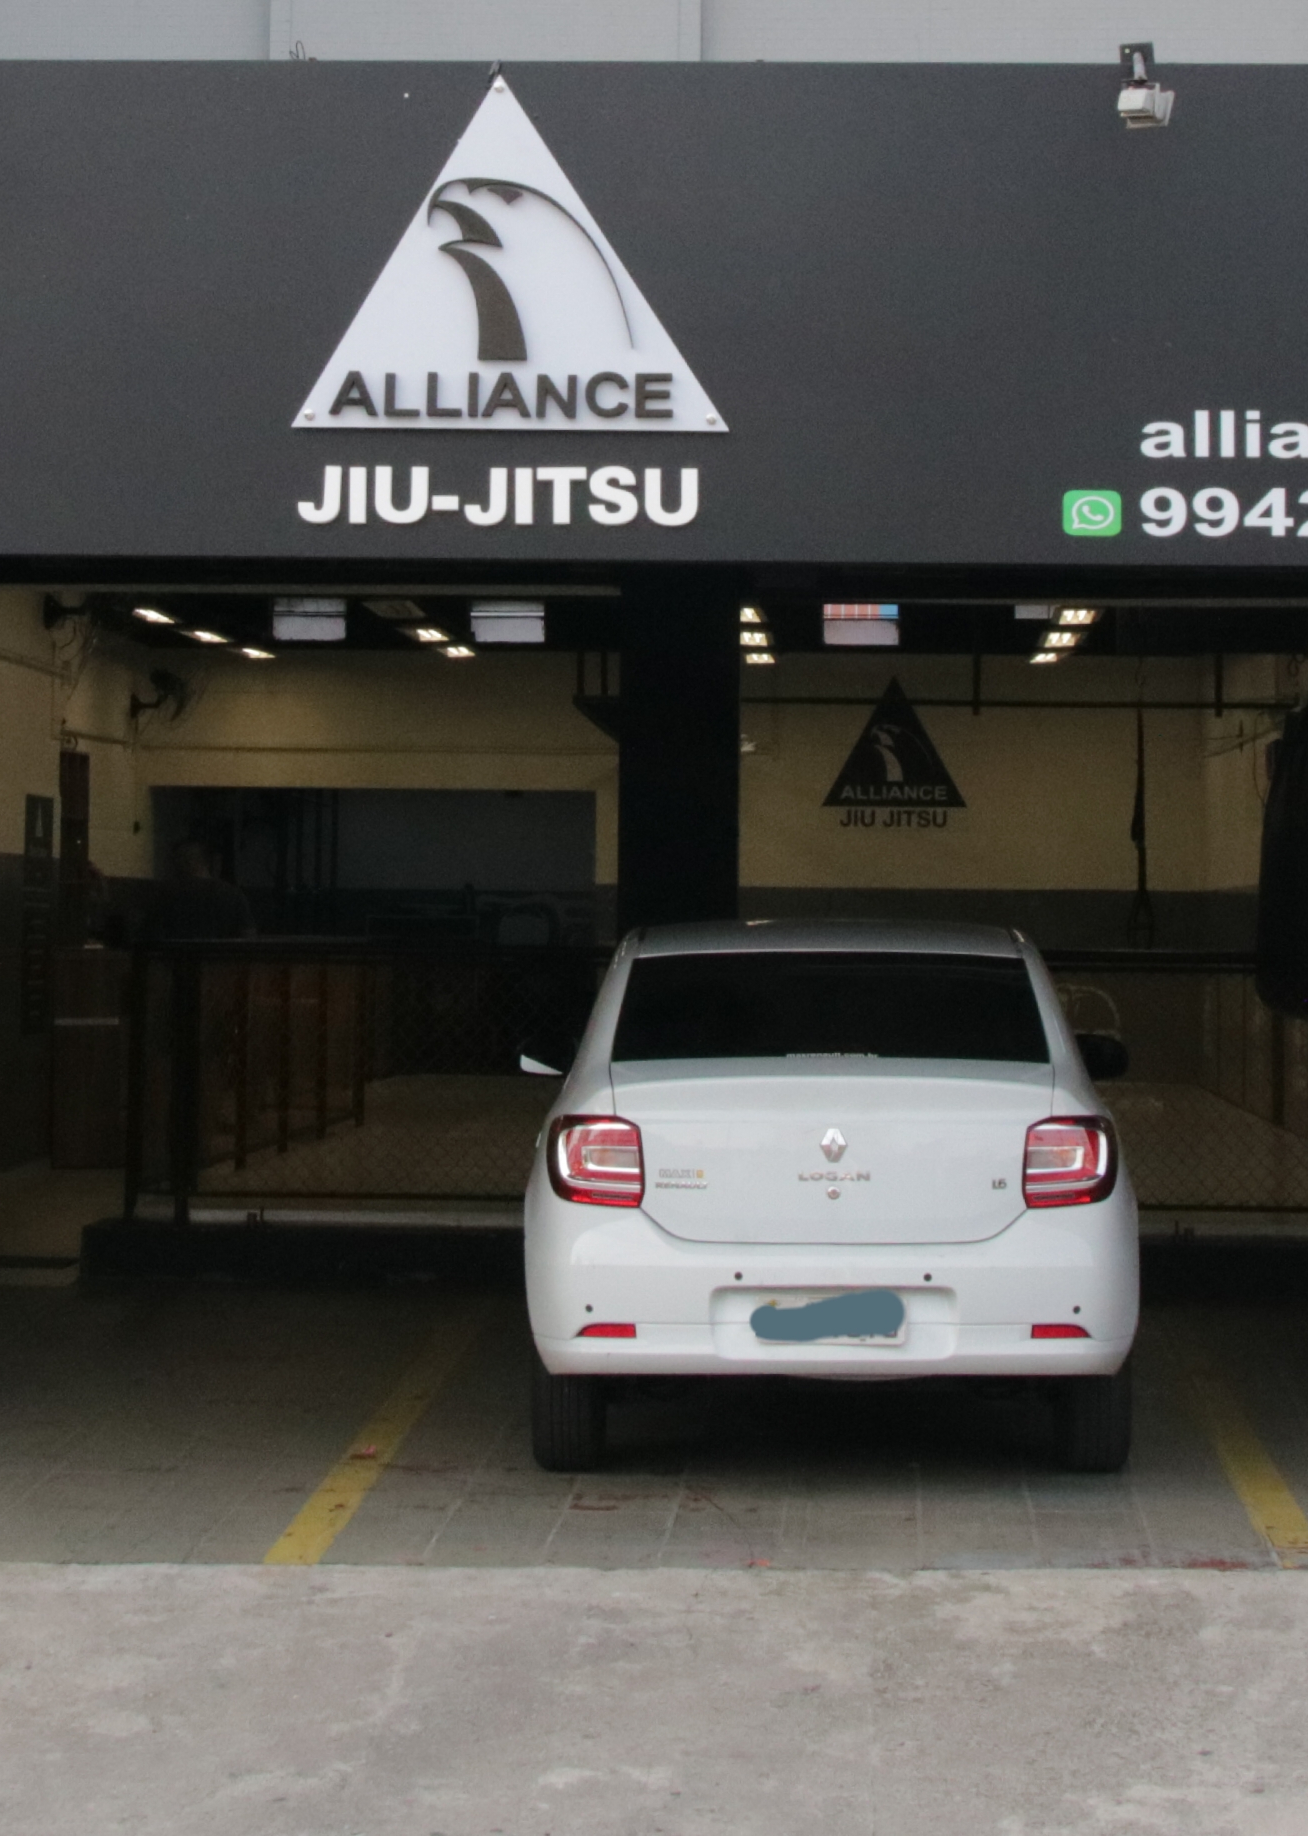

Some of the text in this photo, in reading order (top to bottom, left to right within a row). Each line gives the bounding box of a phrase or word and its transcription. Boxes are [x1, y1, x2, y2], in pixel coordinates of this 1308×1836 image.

[328, 370, 674, 421] ALLIANCE
[297, 465, 699, 527] JIU-JITSU
[840, 784, 948, 801] ALLIANCE
[839, 809, 948, 829] JIU JITSU
[798, 1171, 871, 1182] LOGAN
